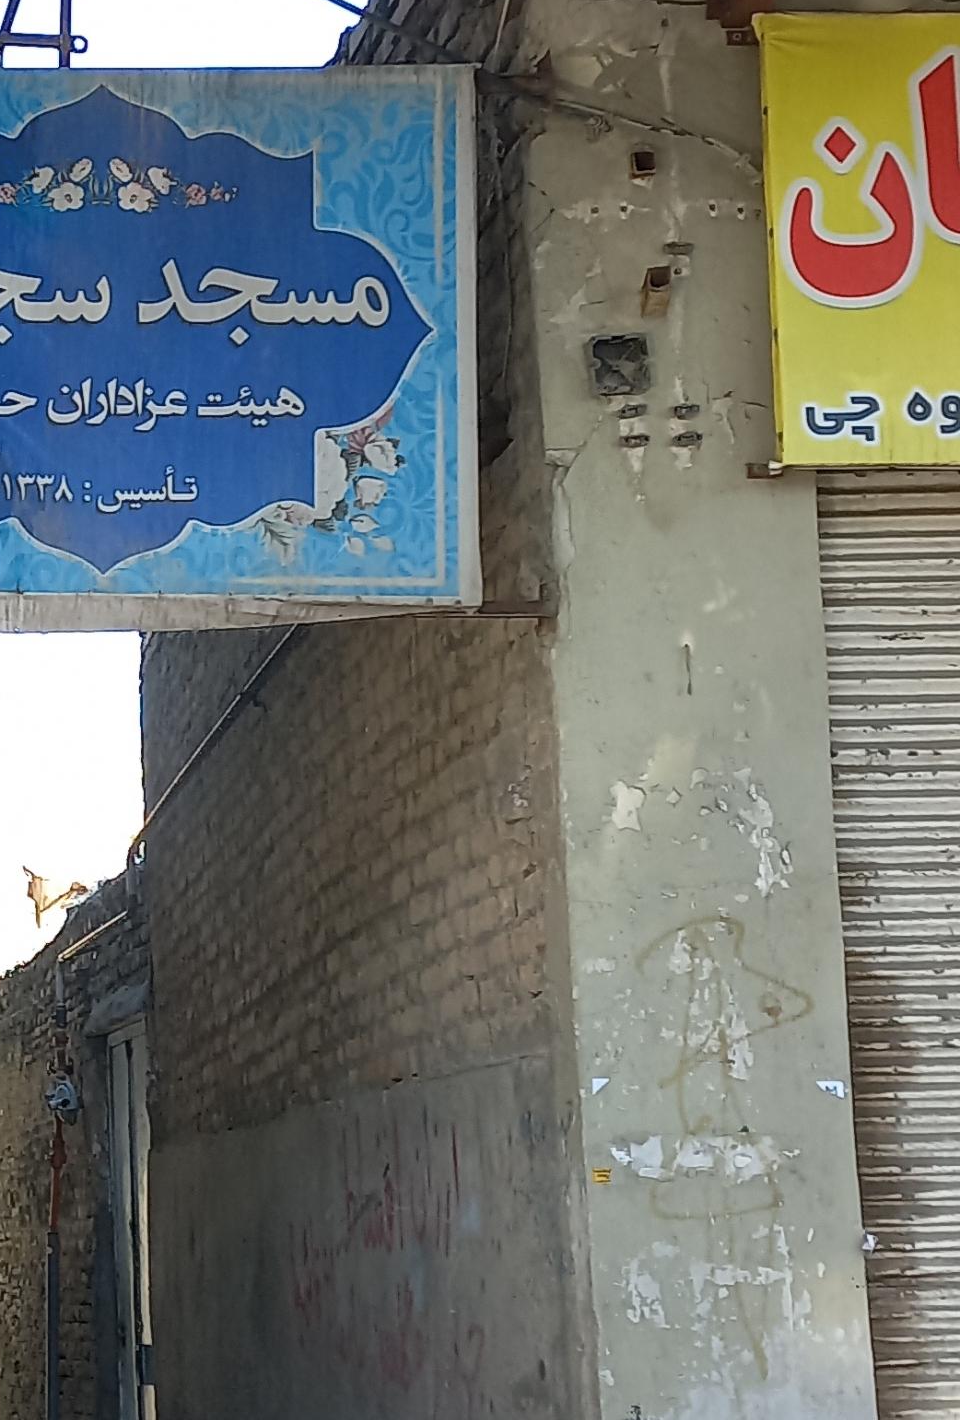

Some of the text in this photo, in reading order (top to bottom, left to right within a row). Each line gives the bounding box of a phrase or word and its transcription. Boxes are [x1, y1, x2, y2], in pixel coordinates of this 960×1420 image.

[138, 258, 390, 346] مسجد
[47, 378, 188, 431] عزاداران
[197, 385, 306, 427] هیئت
[805, 396, 880, 442] چی
[2, 474, 74, 501] ۱۳۳۸
